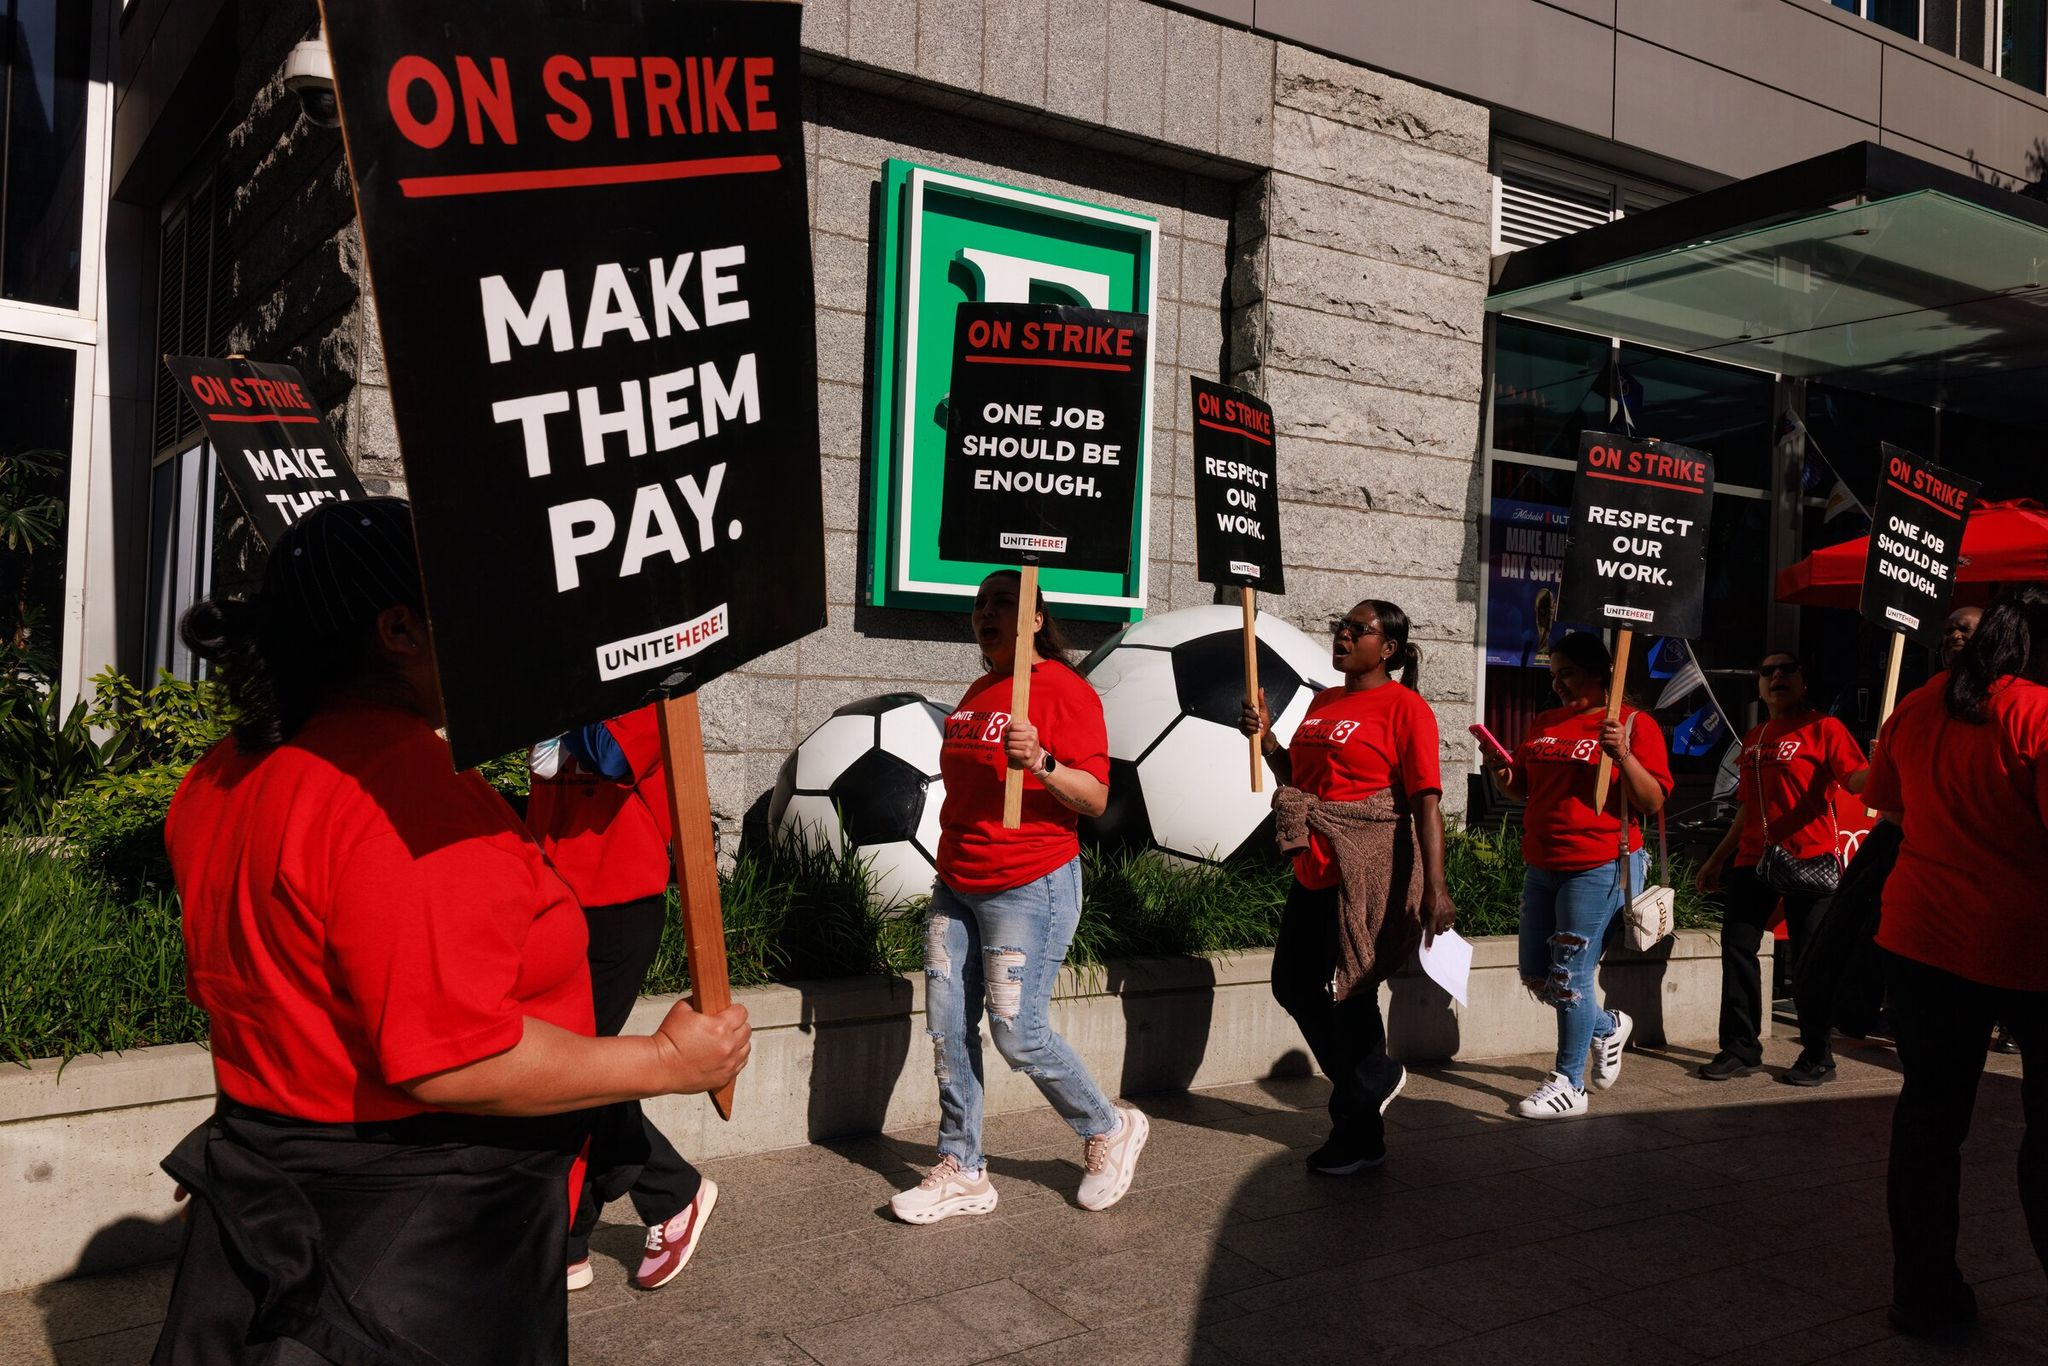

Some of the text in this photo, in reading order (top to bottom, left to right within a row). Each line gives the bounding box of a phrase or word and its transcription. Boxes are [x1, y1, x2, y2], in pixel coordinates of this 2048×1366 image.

[387, 54, 778, 149] ON STRIKE
[480, 245, 750, 364] MAKE
[968, 320, 1134, 357] ON STRIKE
[191, 375, 312, 409] ON STRIKE
[492, 353, 761, 478] THEM
[983, 402, 1105, 431] ONE JOB
[1199, 392, 1271, 435] ON STRIKE
[243, 447, 337, 482] MAKE
[962, 435, 1121, 466] SHOULD BE
[1589, 446, 1706, 483] ON STRIKE
[974, 469, 1102, 499] ENOUGH.
[1205, 456, 1269, 490] RESPECT
[1889, 457, 1968, 511] ON STRIKE
[265, 489, 350, 526] TH
[1226, 488, 1257, 512] OUR
[548, 462, 743, 593] PAY.
[1217, 513, 1265, 541] WORK.
[1587, 506, 1693, 537] RESPECT
[1889, 516, 1945, 554] ONE JOB
[1505, 526, 1542, 555] MAKE
[1612, 536, 1663, 559] OUR
[1877, 533, 1930, 569] SHOULD
[1930, 559, 1949, 580] BE
[1501, 552, 1527, 579] DAY
[1596, 558, 1673, 587] WORK.
[1879, 558, 1938, 599] ENOUGH.
